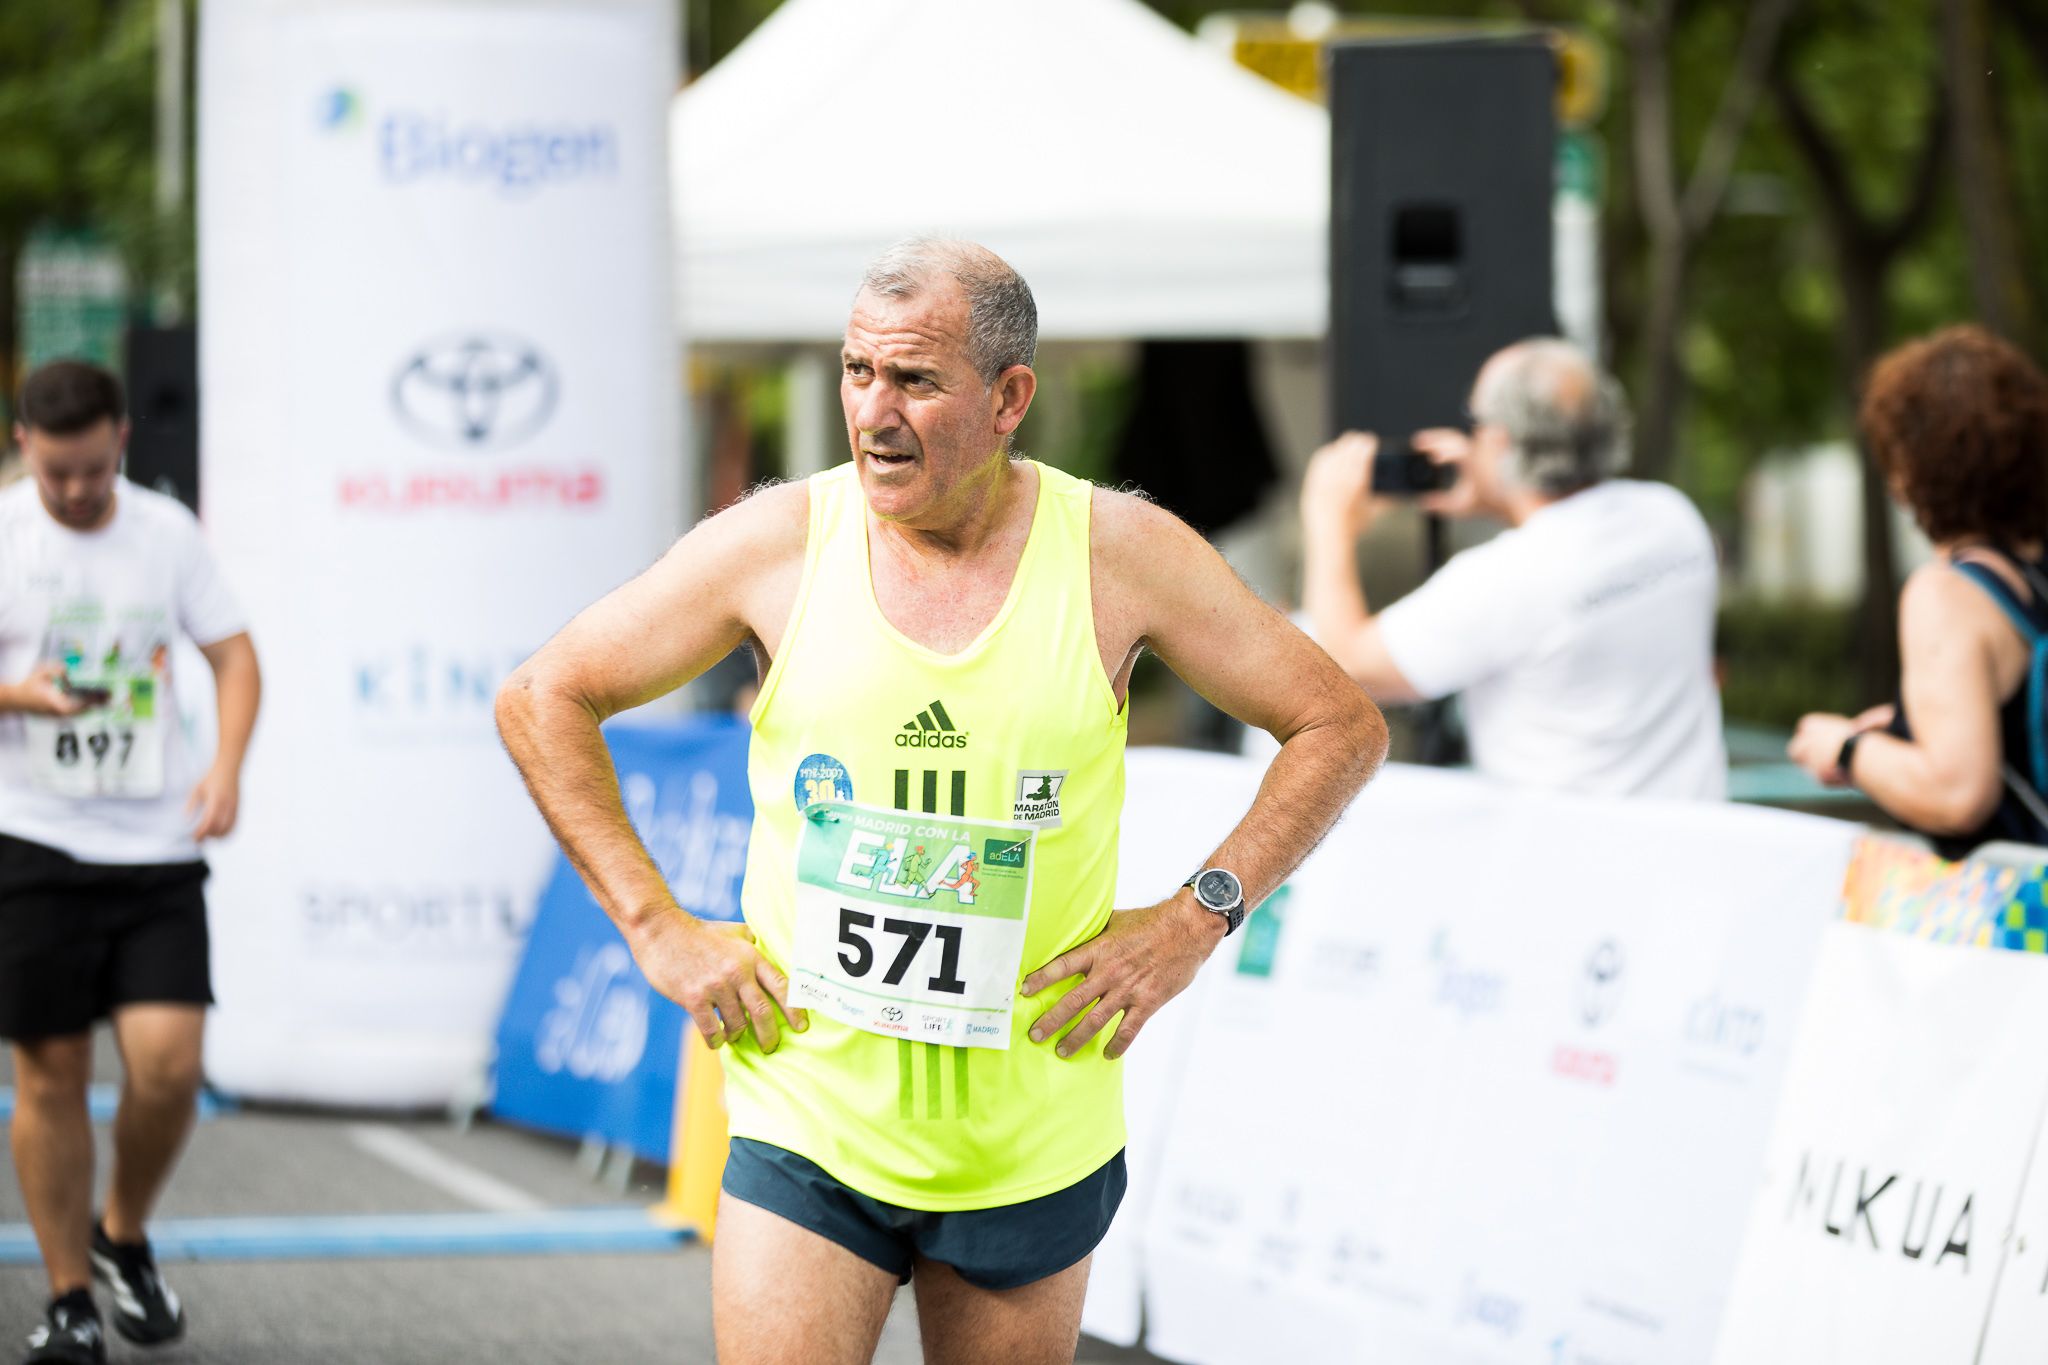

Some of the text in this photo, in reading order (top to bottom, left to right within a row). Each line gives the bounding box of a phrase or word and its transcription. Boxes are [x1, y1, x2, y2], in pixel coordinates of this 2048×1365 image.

[55, 730, 135, 770] 897
[895, 730, 967, 748] adidas
[1014, 800, 1059, 812] MARATON
[1024, 808, 1060, 820] MADRID
[854, 815, 911, 835] MADRID
[915, 826, 948, 839] CON
[952, 830, 971, 841] LA
[835, 829, 975, 905] ELA
[837, 907, 966, 994] 571
[973, 1026, 1000, 1035] MADRID
